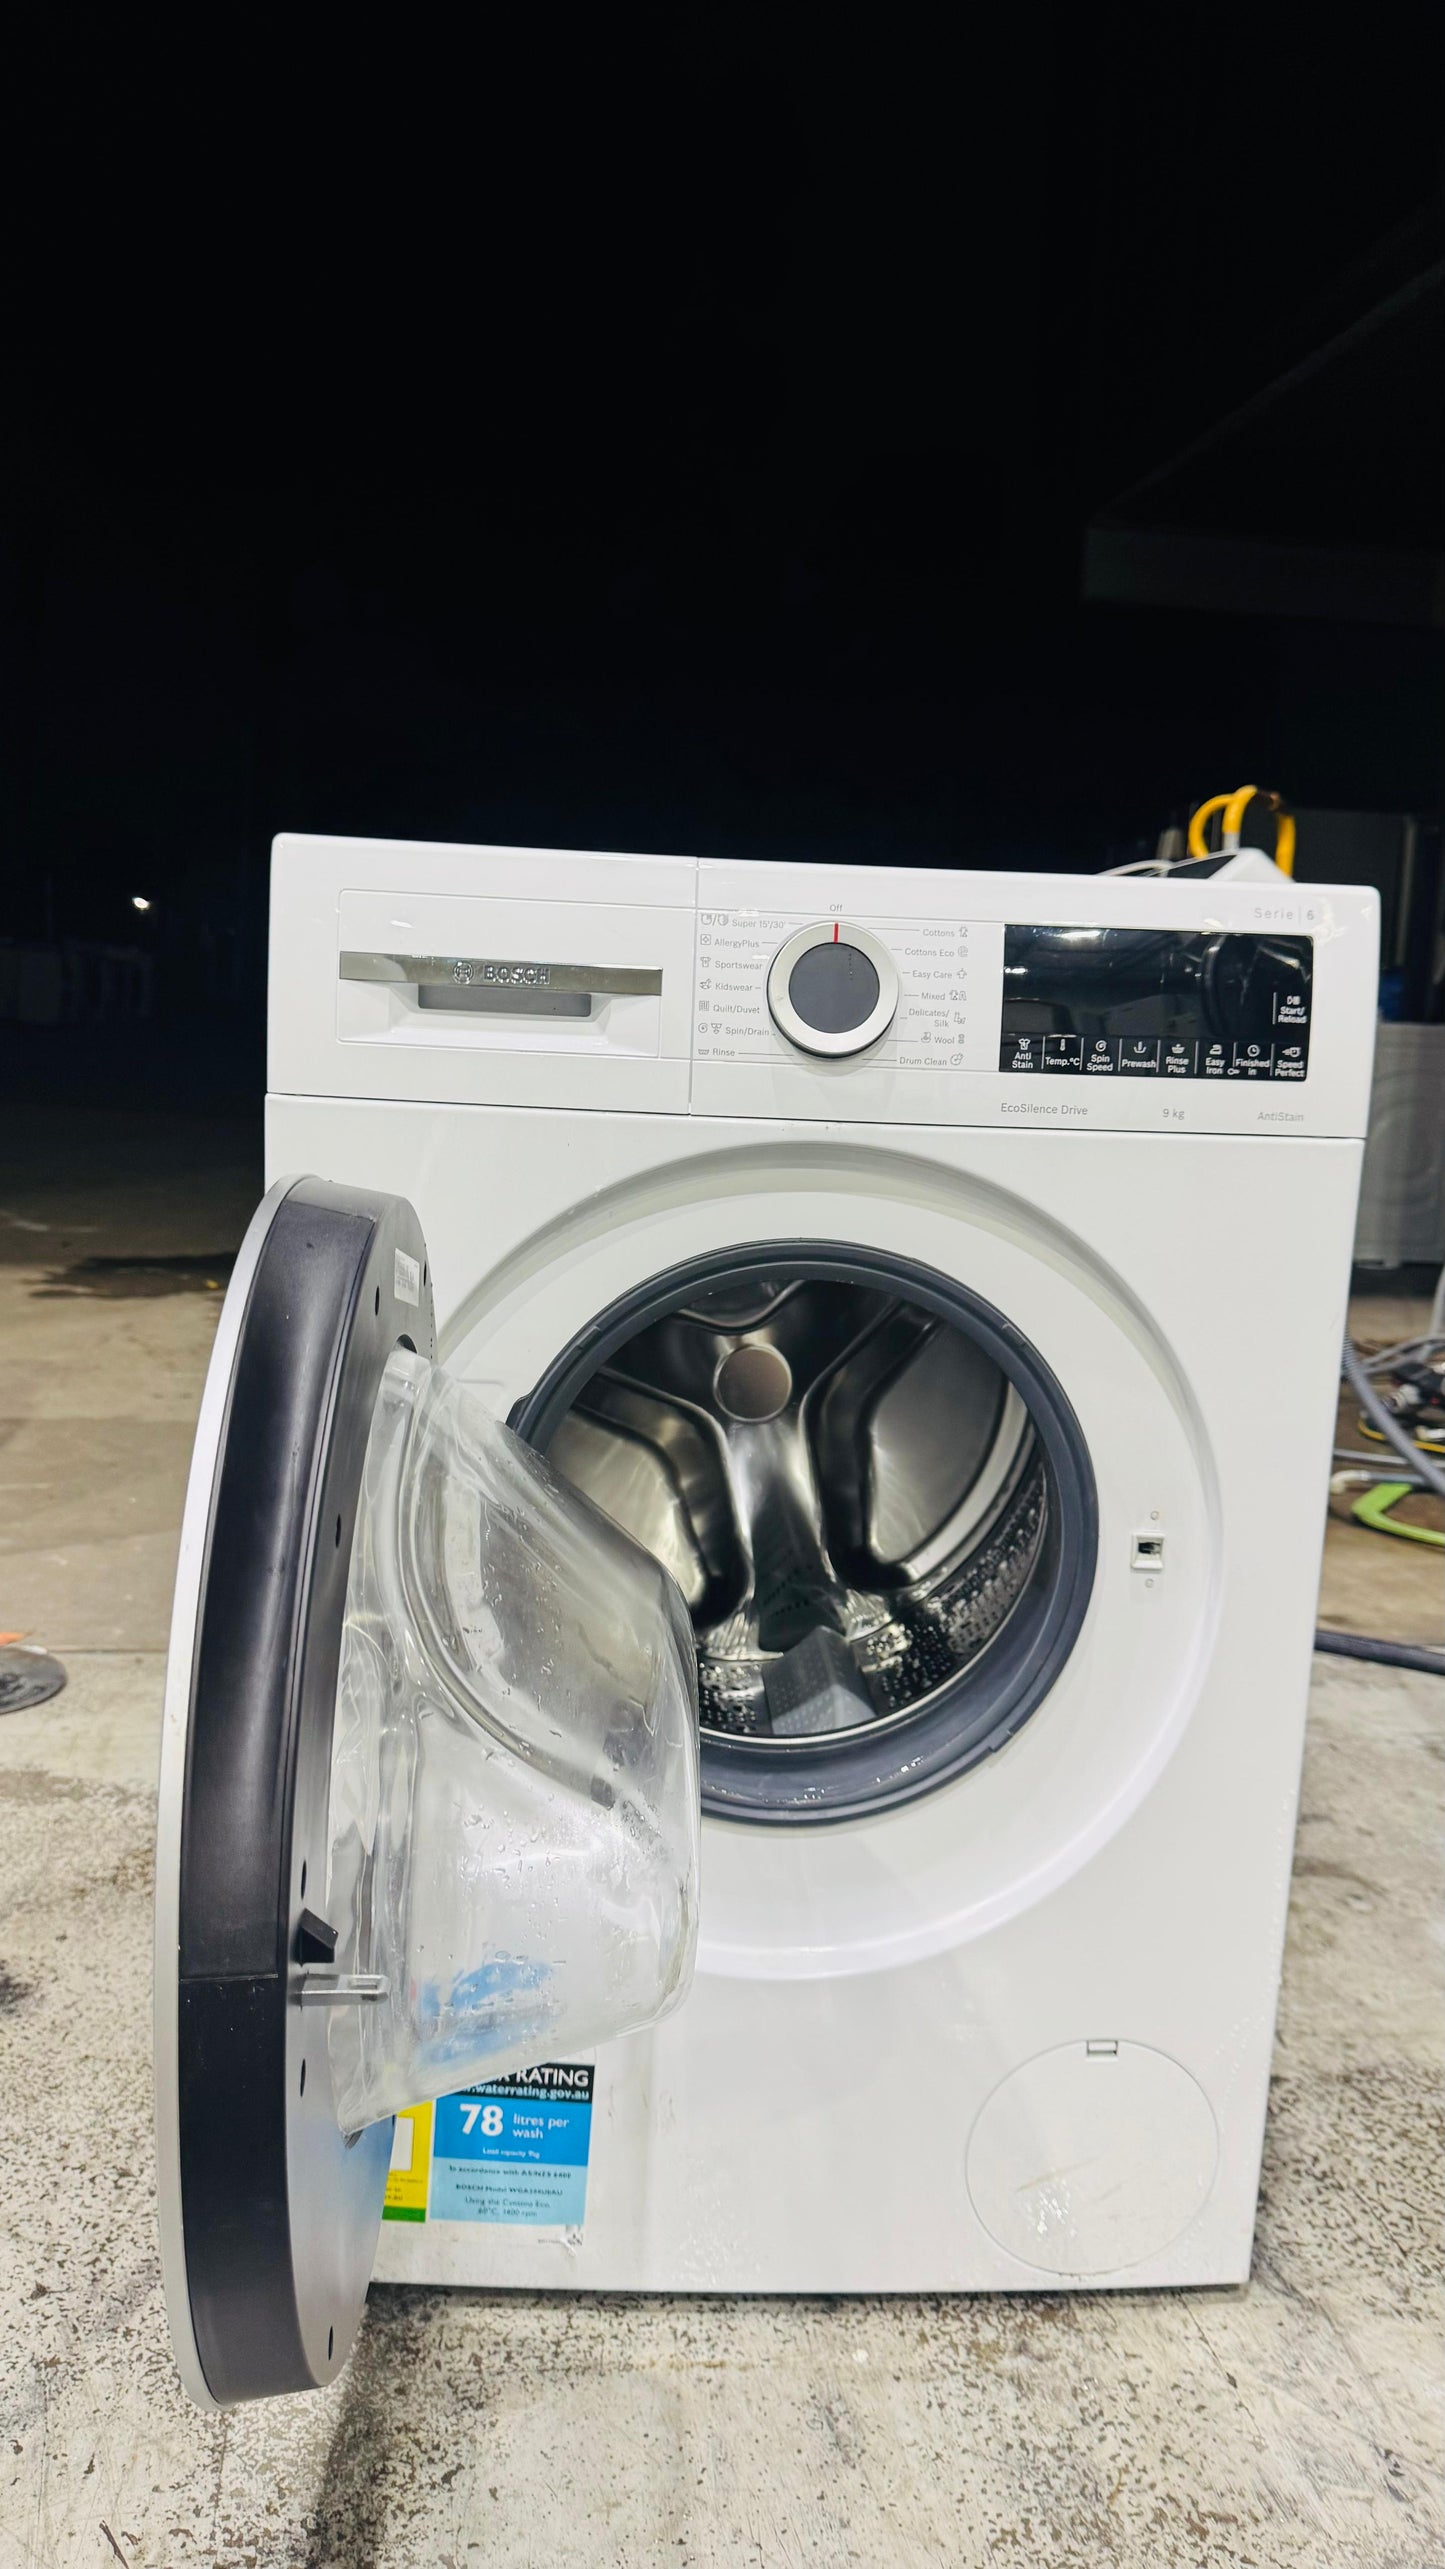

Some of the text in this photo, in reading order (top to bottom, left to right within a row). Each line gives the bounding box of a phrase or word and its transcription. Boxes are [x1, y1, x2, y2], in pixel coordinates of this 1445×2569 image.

[829, 904, 843, 912] Off
[1254, 907, 1315, 921] Serie 6
[731, 918, 757, 929] Super
[922, 928, 955, 938] Cottons
[714, 938, 760, 949] AllergyPlus
[904, 948, 955, 958] Cottons Eco
[715, 960, 763, 970] Sportswear
[483, 965, 550, 985] BOSCH
[912, 970, 953, 980] Easy Care
[715, 982, 753, 992] Kidswear
[921, 991, 946, 1001] Mixed
[713, 1004, 760, 1015] Quilt/Duvet
[908, 1008, 949, 1018] Delicates/
[1280, 1006, 1305, 1016] Start/
[934, 1019, 949, 1028] Silk
[1278, 1014, 1307, 1024] Reload
[725, 1026, 770, 1037] Spin/Drain
[934, 1035, 955, 1044] Wool
[712, 1048, 736, 1057] Rinse
[1014, 1051, 1032, 1060] Anti
[899, 1056, 948, 1066] Drum Clean
[1045, 1056, 1080, 1067] Temp.°C
[1090, 1054, 1111, 1063] Spin
[1165, 1056, 1189, 1065] Rinse
[1205, 1058, 1226, 1067] Easy
[1235, 1058, 1270, 1068] Finished
[1012, 1060, 1033, 1069] Stain
[1086, 1062, 1114, 1072] Speed
[1121, 1059, 1157, 1069] Prewash
[1276, 1060, 1304, 1070] Speed
[1167, 1065, 1187, 1074] Plus
[1206, 1066, 1223, 1075] Iron
[1247, 1067, 1257, 1076] in
[1275, 1068, 1306, 1078] Perfect
[1000, 1102, 1089, 1116] EcoSilence Drive
[1162, 1108, 1185, 1121] 9 kg
[1257, 1111, 1305, 1122] AntiStain
[516, 2067, 589, 2088] RATING
[459, 2103, 504, 2136] 78
[513, 2113, 570, 2129] litres per
[512, 2128, 544, 2140] wash
[456, 2183, 484, 2191] BOSCH
